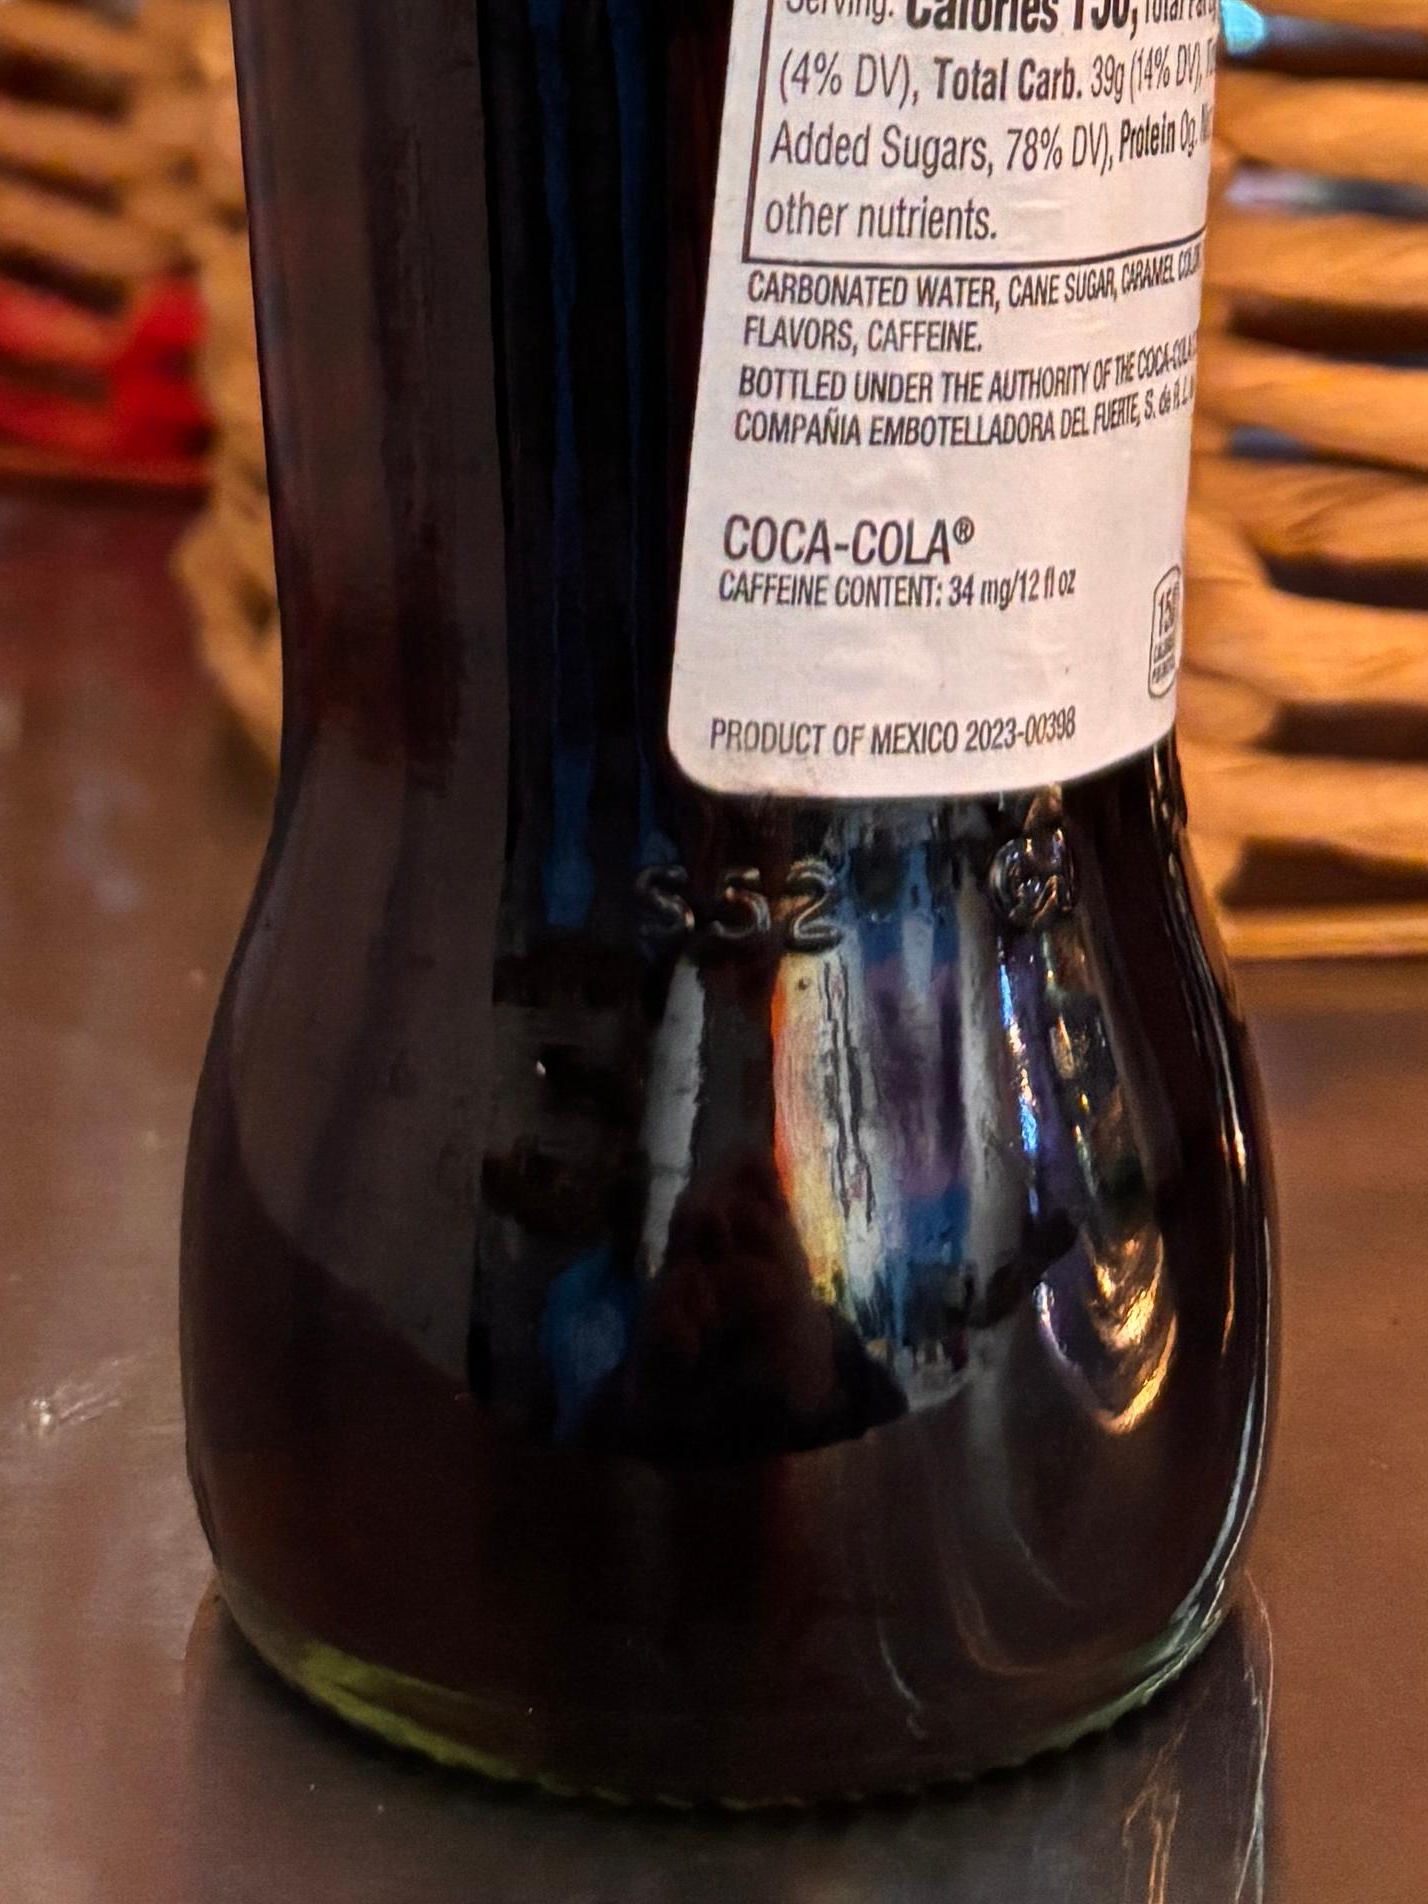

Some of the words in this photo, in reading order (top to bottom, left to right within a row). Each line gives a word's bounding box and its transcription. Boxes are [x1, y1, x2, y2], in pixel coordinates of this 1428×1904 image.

[779, 49, 842, 102] (4%
[856, 54, 919, 109] DV),
[933, 57, 1007, 100] Total
[1017, 57, 1082, 100] Carb.
[1091, 56, 1125, 107] 39g
[1130, 44, 1170, 104] (14%
[769, 120, 870, 166] Added
[881, 124, 995, 177] Sugars,
[1006, 128, 1063, 171] 78%
[1071, 125, 1115, 175] DV),
[1119, 111, 1176, 162] Protein
[765, 193, 849, 236] other
[857, 200, 998, 240] nutrients.
[747, 270, 907, 307] CARBONATED
[916, 271, 1001, 312] WATER,
[1008, 267, 1061, 310] CANE
[1064, 267, 1118, 304] SUGAR,
[1121, 252, 1174, 295] CARAMEL
[743, 316, 859, 357] FLAVORS,
[868, 321, 983, 352] CAFFEINE.
[739, 365, 846, 401] BOTTLED
[855, 371, 933, 403] UNDER
[940, 371, 984, 403] THE
[989, 357, 1088, 402] AUTHORITY
[1093, 357, 1112, 393] OF
[1115, 350, 1135, 386] THE
[734, 408, 861, 447] COMPAÑIA
[868, 410, 1056, 447] EMBOTELLADORA
[1059, 405, 1090, 440] DEL
[1093, 391, 1141, 435] FUERTE,
[717, 569, 827, 607] CAFFEINE
[834, 574, 943, 607] CONTENT:
[948, 575, 973, 607] 34
[981, 570, 1040, 611] mg/12
[1060, 569, 1076, 597] oz
[709, 717, 824, 753] PRODUCT
[832, 722, 864, 753] OF
[871, 721, 959, 755] MEXICO
[964, 707, 1076, 753] 2023-00398
